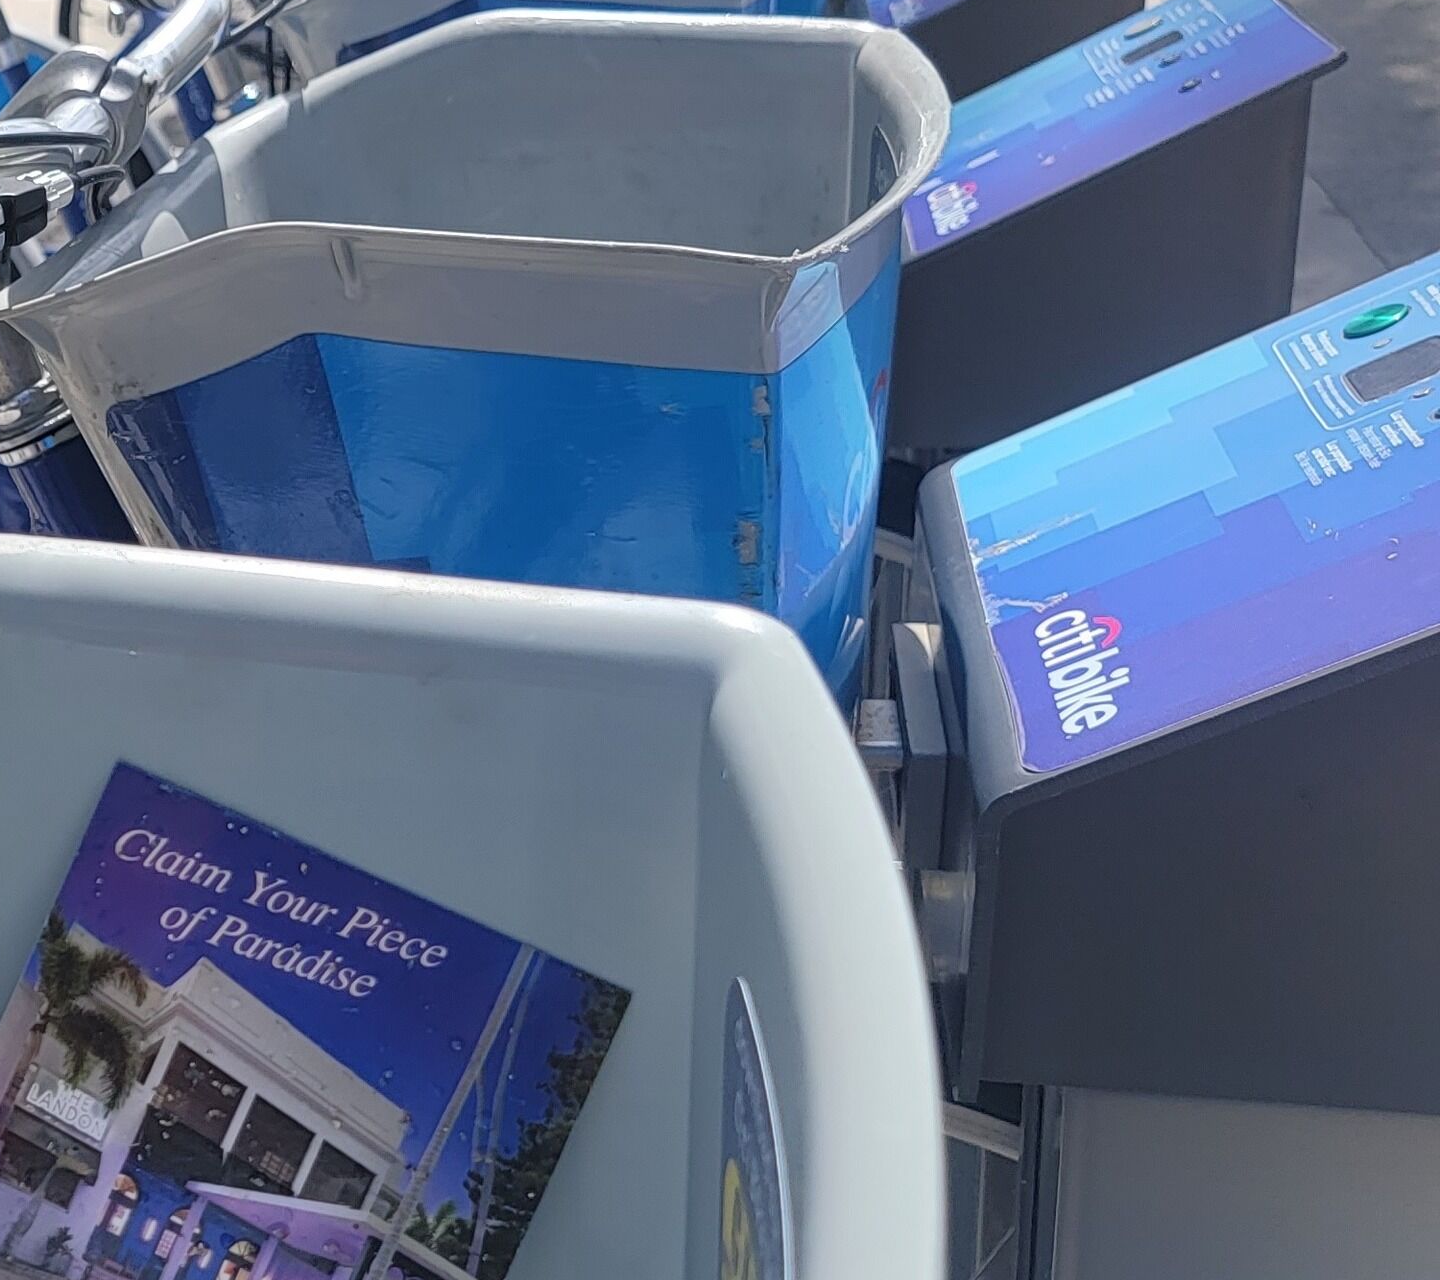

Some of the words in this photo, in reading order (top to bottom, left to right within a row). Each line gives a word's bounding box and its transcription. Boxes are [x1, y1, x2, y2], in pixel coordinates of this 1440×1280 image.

[113, 827, 234, 894] Claim
[243, 870, 339, 924] Your
[336, 906, 449, 969] Piece
[160, 903, 216, 943] of
[206, 913, 378, 999] Paradise
[26, 1082, 109, 1138] LANDON
